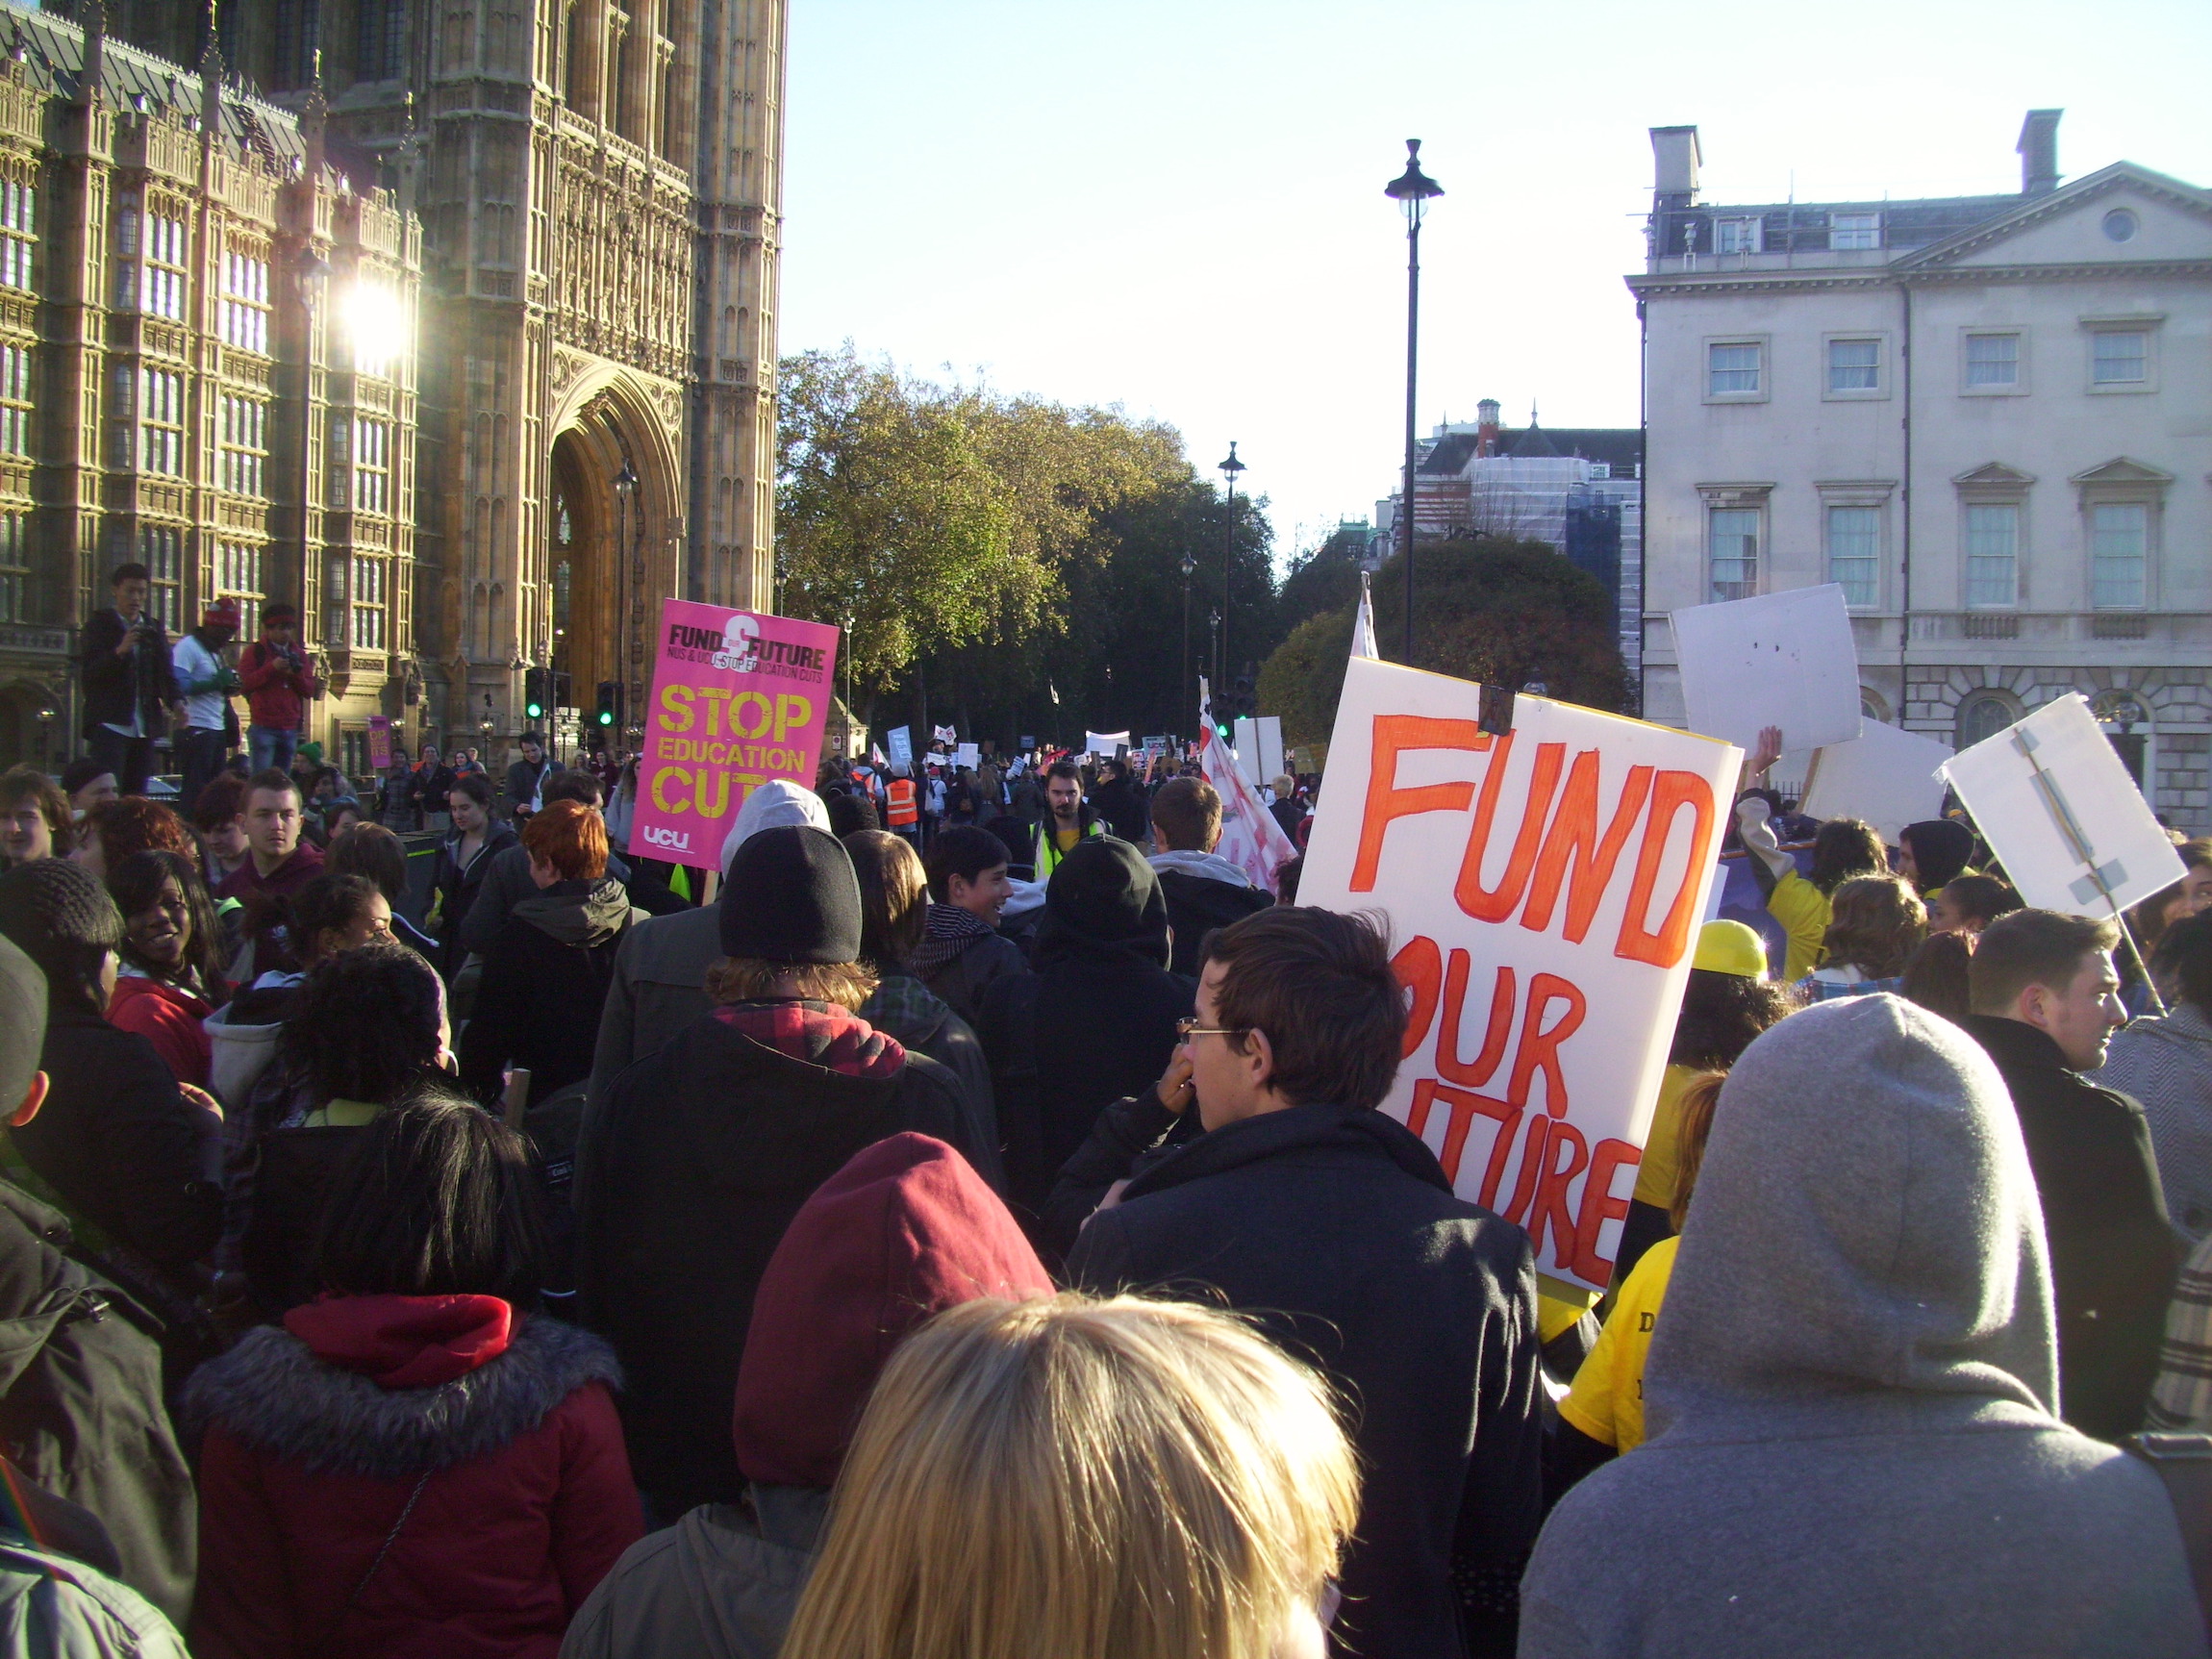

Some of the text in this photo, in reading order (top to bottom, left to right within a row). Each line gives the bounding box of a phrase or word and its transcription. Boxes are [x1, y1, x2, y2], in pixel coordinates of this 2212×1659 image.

[667, 646, 686, 661] NUS
[688, 649, 696, 662] &
[721, 657, 744, 670] STOP
[746, 661, 798, 680] EDUCATION
[799, 669, 823, 684] CUTS
[669, 624, 723, 652] FUND
[747, 638, 826, 670] FUTURE
[658, 685, 813, 742] STOP
[658, 737, 806, 773] EDUCATION
[651, 766, 800, 818] CUT
[1348, 715, 1716, 968] FUND
[1405, 1078, 1644, 1289] TURE
[1639, 1312, 1655, 1333] D
